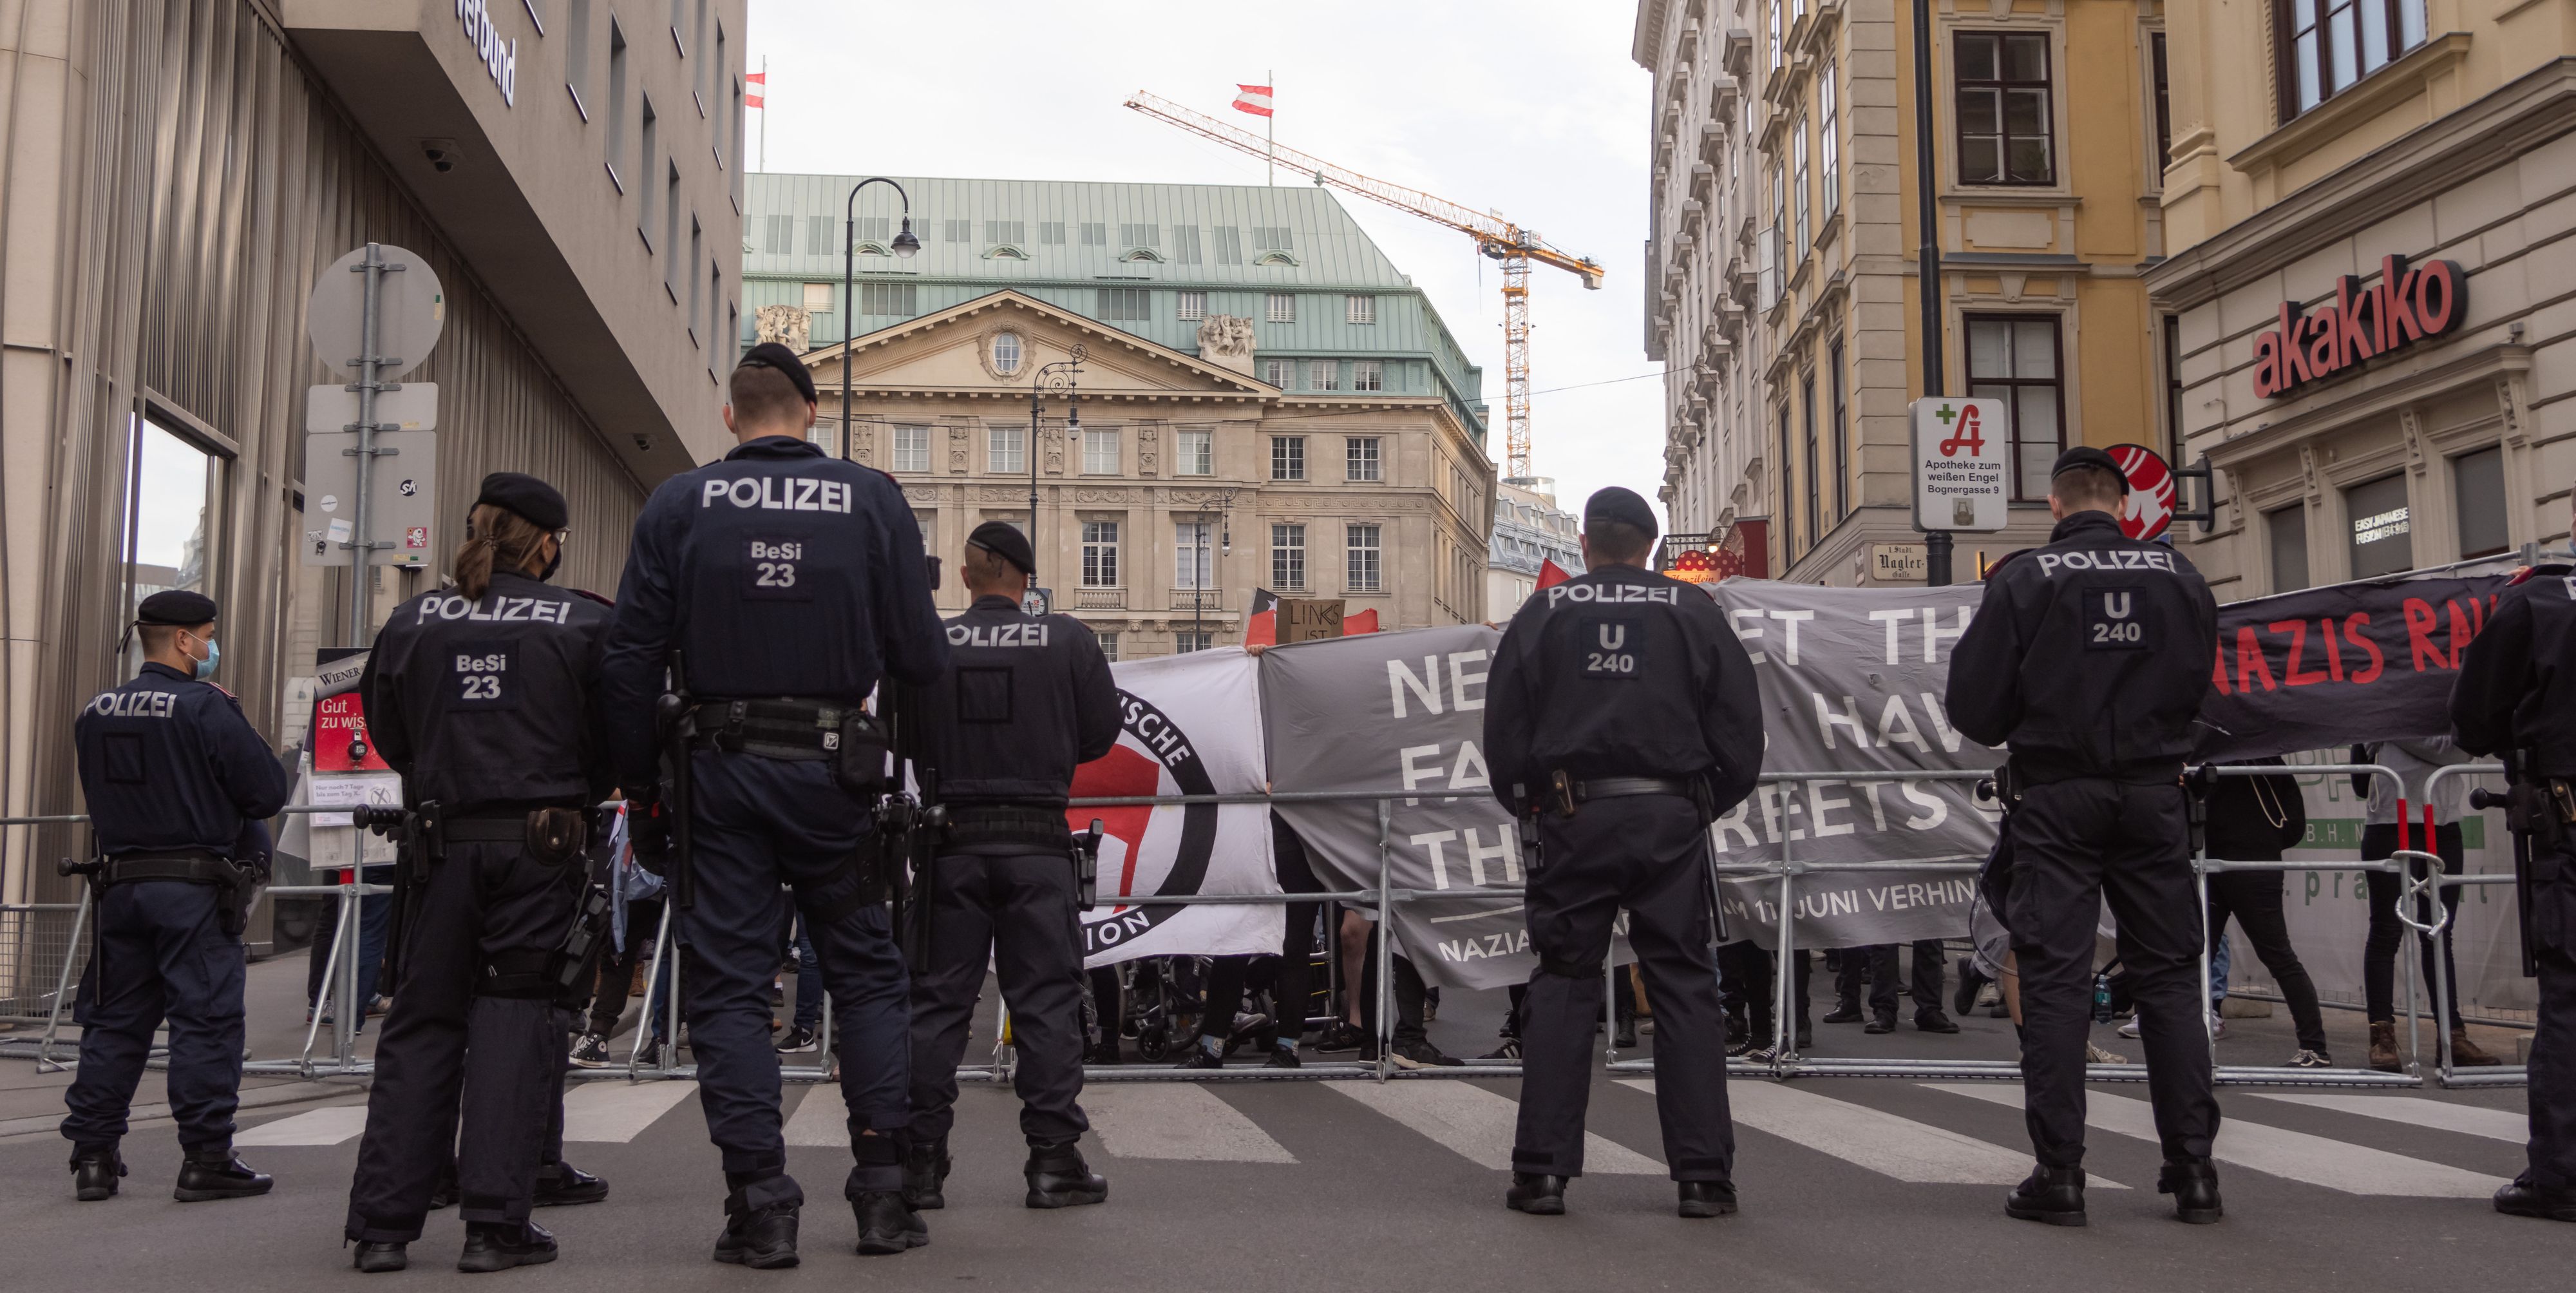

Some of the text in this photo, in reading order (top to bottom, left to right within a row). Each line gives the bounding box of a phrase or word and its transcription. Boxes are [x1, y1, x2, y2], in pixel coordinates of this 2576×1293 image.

[2253, 254, 2457, 399] akakiko
[1925, 460, 2001, 470] Apotheke zum
[1927, 485, 1991, 495] Bognergasse
[1928, 472, 1999, 484] weißen Engel
[703, 477, 851, 513] POLIZEI
[751, 541, 802, 560] BeSi
[756, 562, 796, 588] 23
[2037, 551, 2177, 577] POLIZEI
[1548, 584, 1678, 609] POLIZEI
[2104, 592, 2130, 619] U
[417, 595, 572, 625] POLIZEI
[1291, 604, 1340, 626] LINKS
[946, 623, 1048, 647] OLIZEI
[1599, 624, 1625, 650] U
[2093, 622, 2141, 642] 240
[456, 655, 506, 672] BeSi
[1587, 653, 1634, 673] 240
[319, 667, 361, 686] WIENER
[462, 675, 502, 700] 23
[1387, 649, 1495, 719] NE
[84, 691, 178, 718] POLIZEI
[321, 698, 347, 714] Gut
[321, 713, 366, 729] zu wis
[1812, 692, 1967, 753] HAV
[1795, 890, 1860, 919] JUNI
